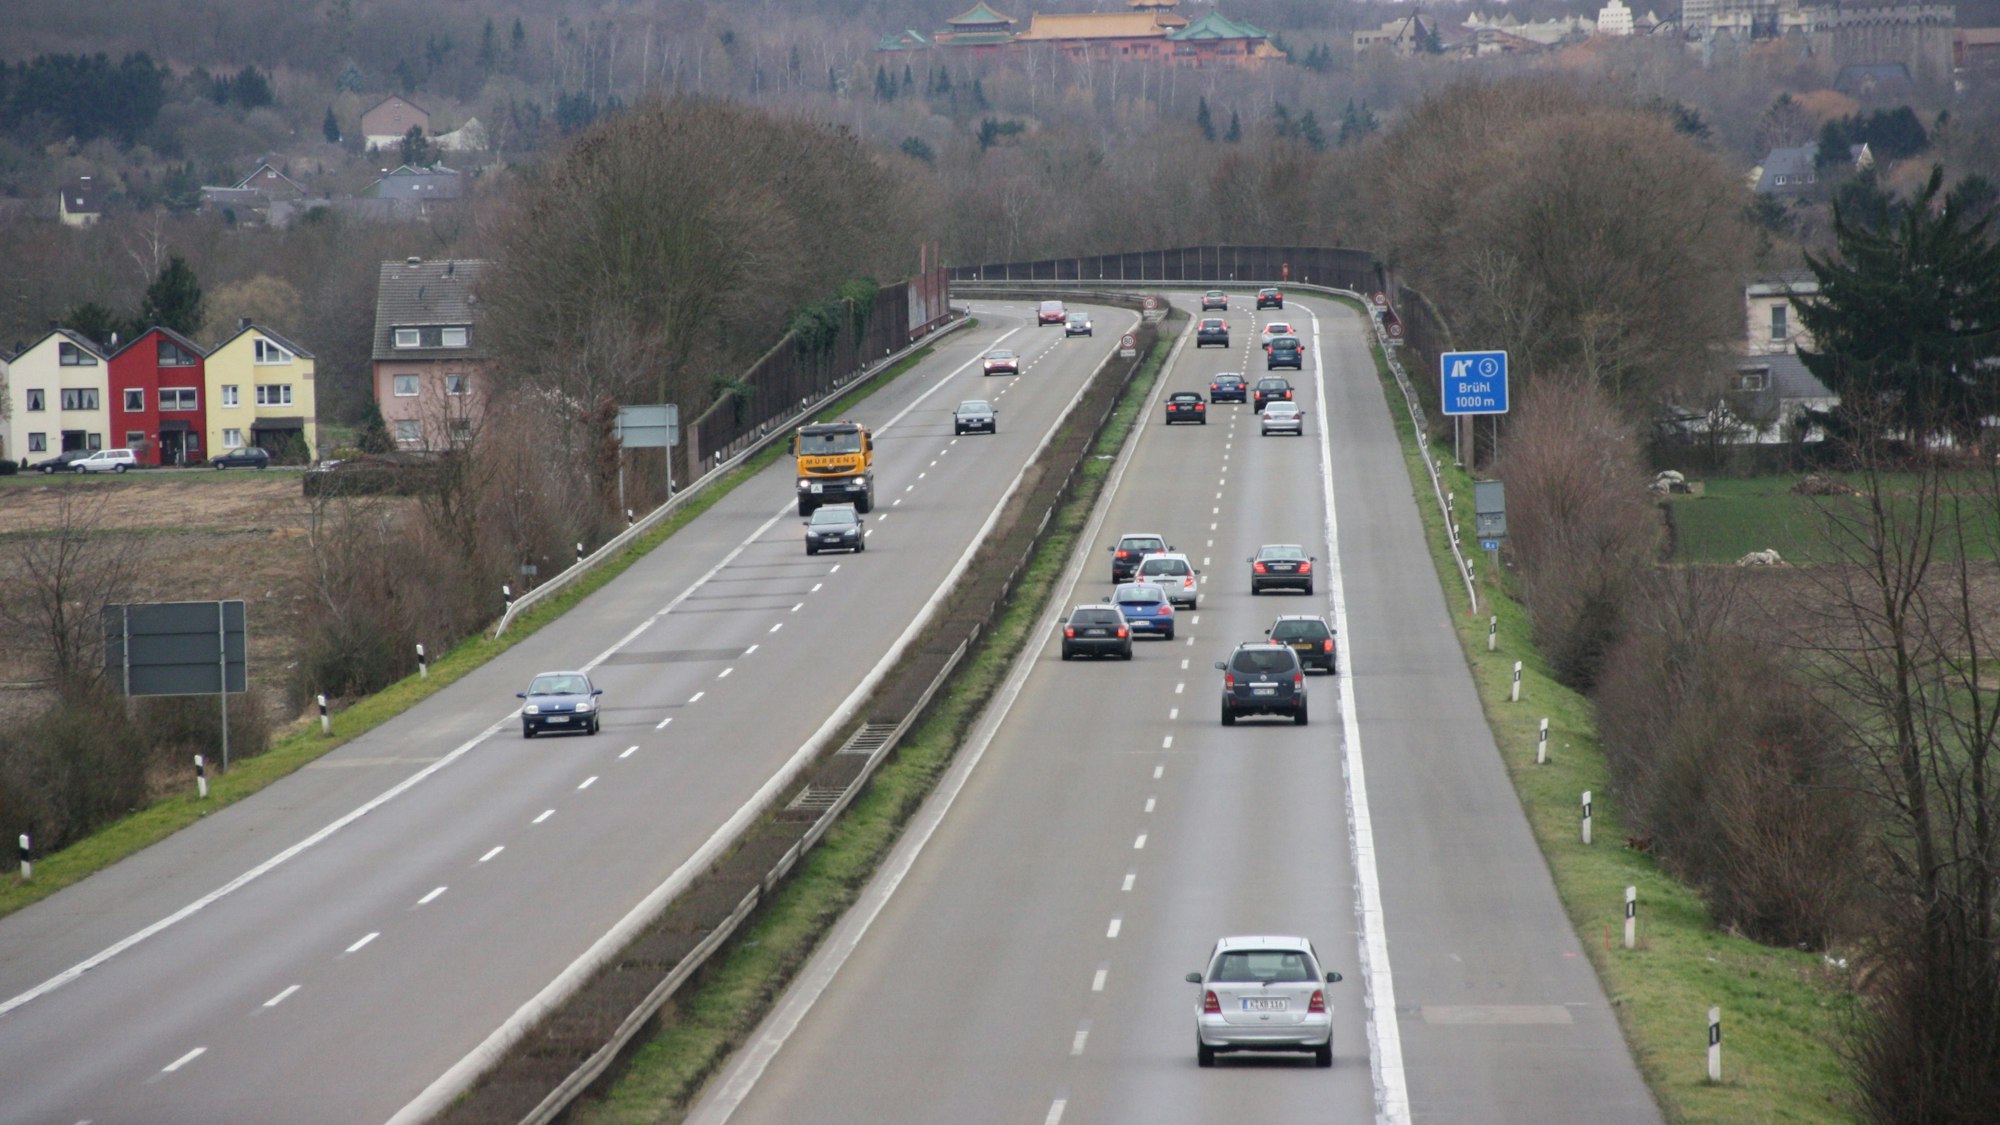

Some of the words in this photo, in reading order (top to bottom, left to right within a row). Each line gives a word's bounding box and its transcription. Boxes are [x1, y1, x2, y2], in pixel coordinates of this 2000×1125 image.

[1484, 362, 1492, 373] 3
[1459, 382, 1491, 393] Brühl
[1456, 396, 1481, 407] 1000
[1484, 398, 1495, 406] m
